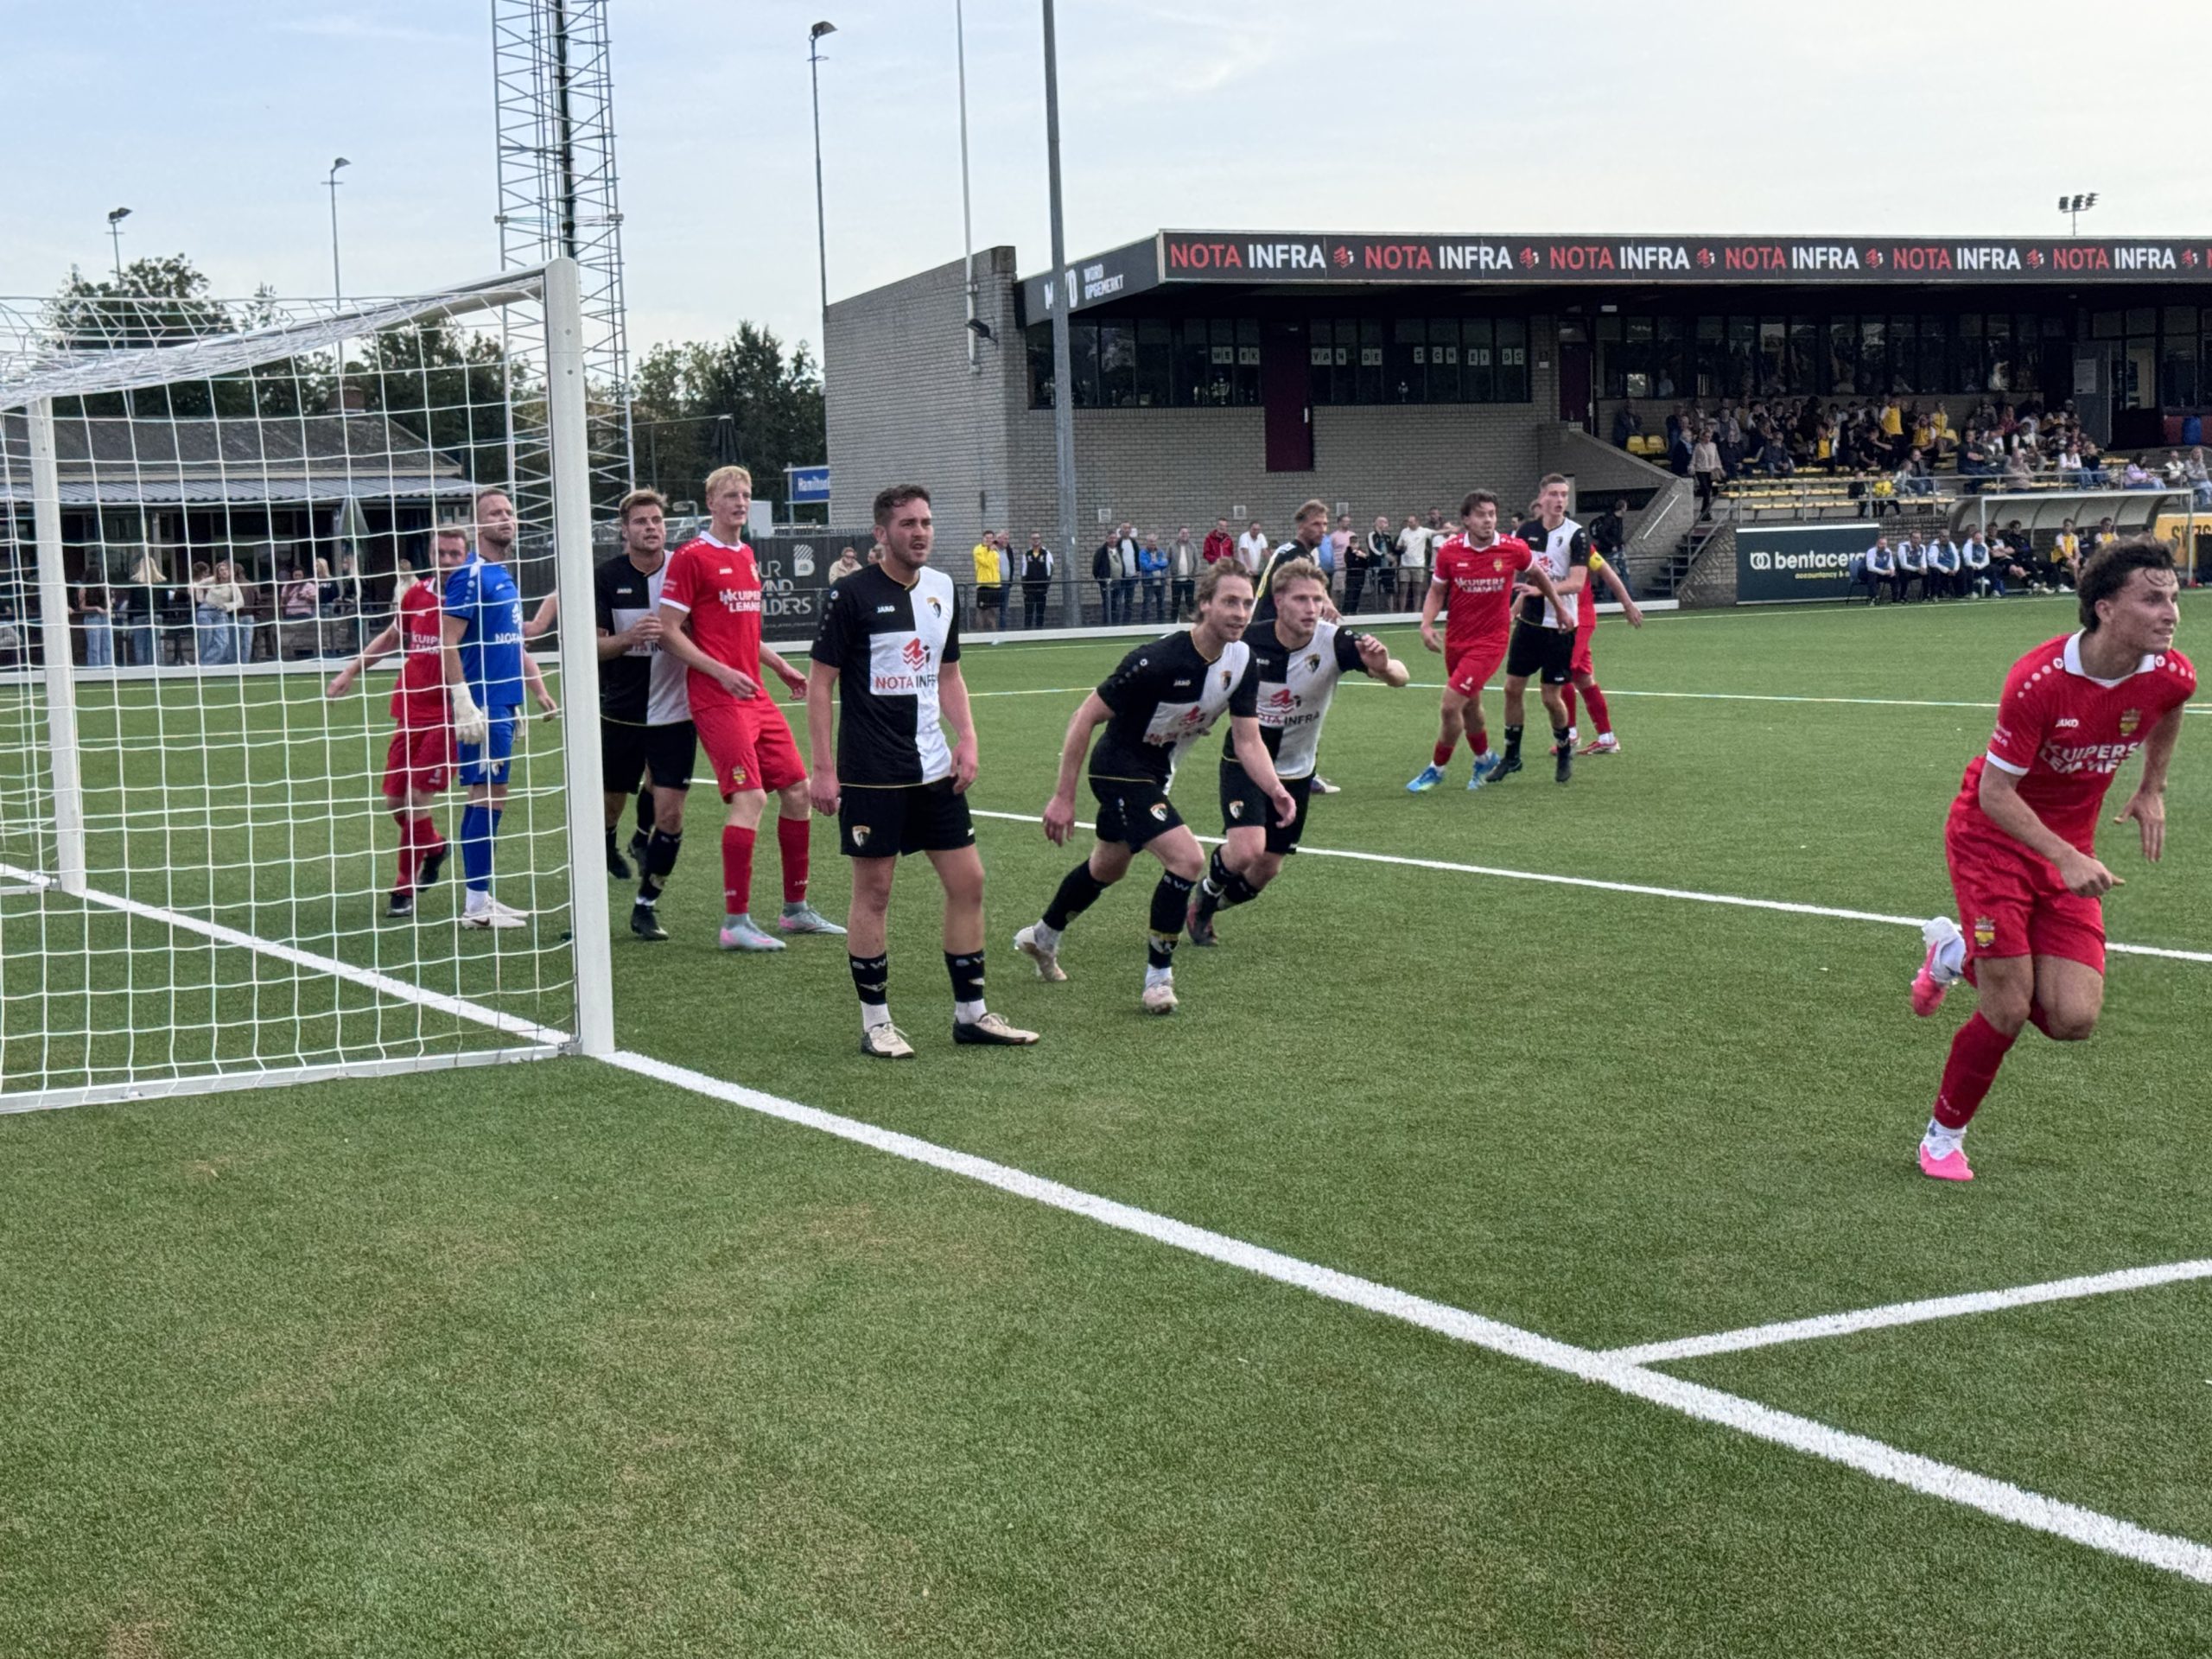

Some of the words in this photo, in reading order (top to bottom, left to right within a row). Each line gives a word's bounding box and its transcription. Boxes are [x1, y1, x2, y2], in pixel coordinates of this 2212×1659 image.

[1170, 244, 1242, 268] NOTA
[1248, 245, 1325, 269] INFRA
[1364, 245, 1433, 269] NOTA
[1439, 246, 1513, 269] INFRA
[1549, 246, 1614, 269] NOTA
[1619, 247, 1690, 269] INFRA
[1725, 247, 1786, 269] NOTA
[1792, 247, 1859, 269] INFRA
[1893, 248, 1951, 270] NOTA
[1956, 248, 2021, 270] INFRA
[2053, 248, 2109, 270] NOTA
[2114, 247, 2176, 270] INFRA
[875, 676, 914, 690] NOTA
